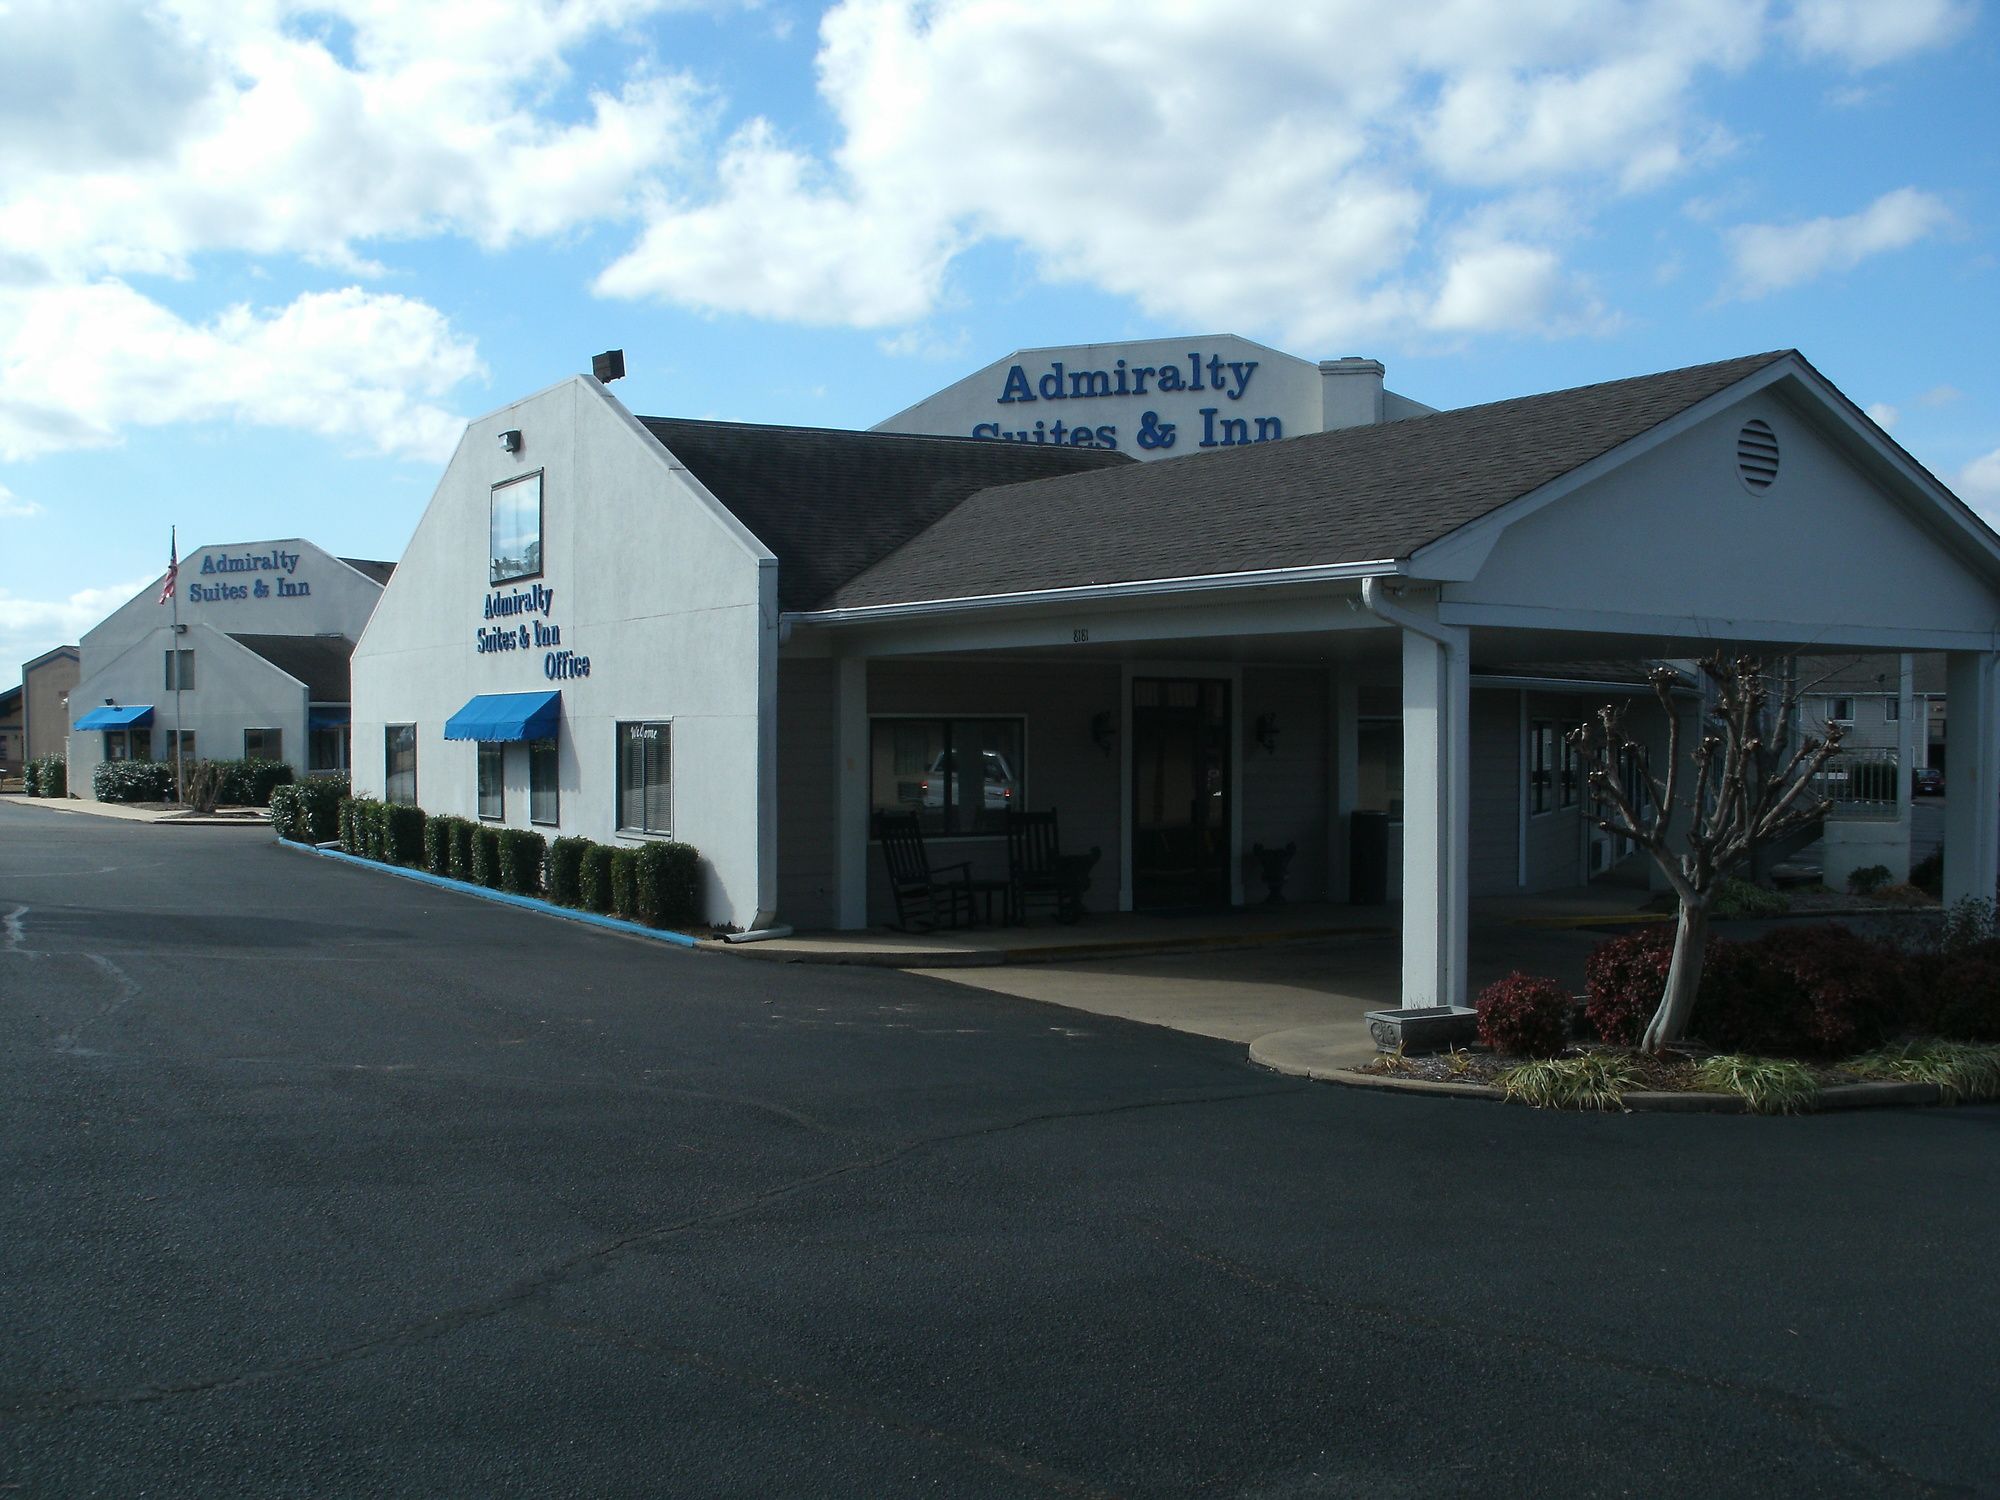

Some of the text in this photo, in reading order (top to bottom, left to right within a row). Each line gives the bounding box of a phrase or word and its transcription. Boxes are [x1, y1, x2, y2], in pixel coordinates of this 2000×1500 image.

[997, 353, 1259, 404] Admiralty
[1136, 411, 1176, 449] &
[1199, 408, 1283, 447] Inn
[200, 550, 300, 575] Admiralty
[190, 577, 311, 602] Suites & Inn
[483, 583, 553, 620] Admiralty
[477, 620, 561, 654] Suites & Inn
[544, 650, 591, 681] Office
[630, 726, 658, 740] Welome
